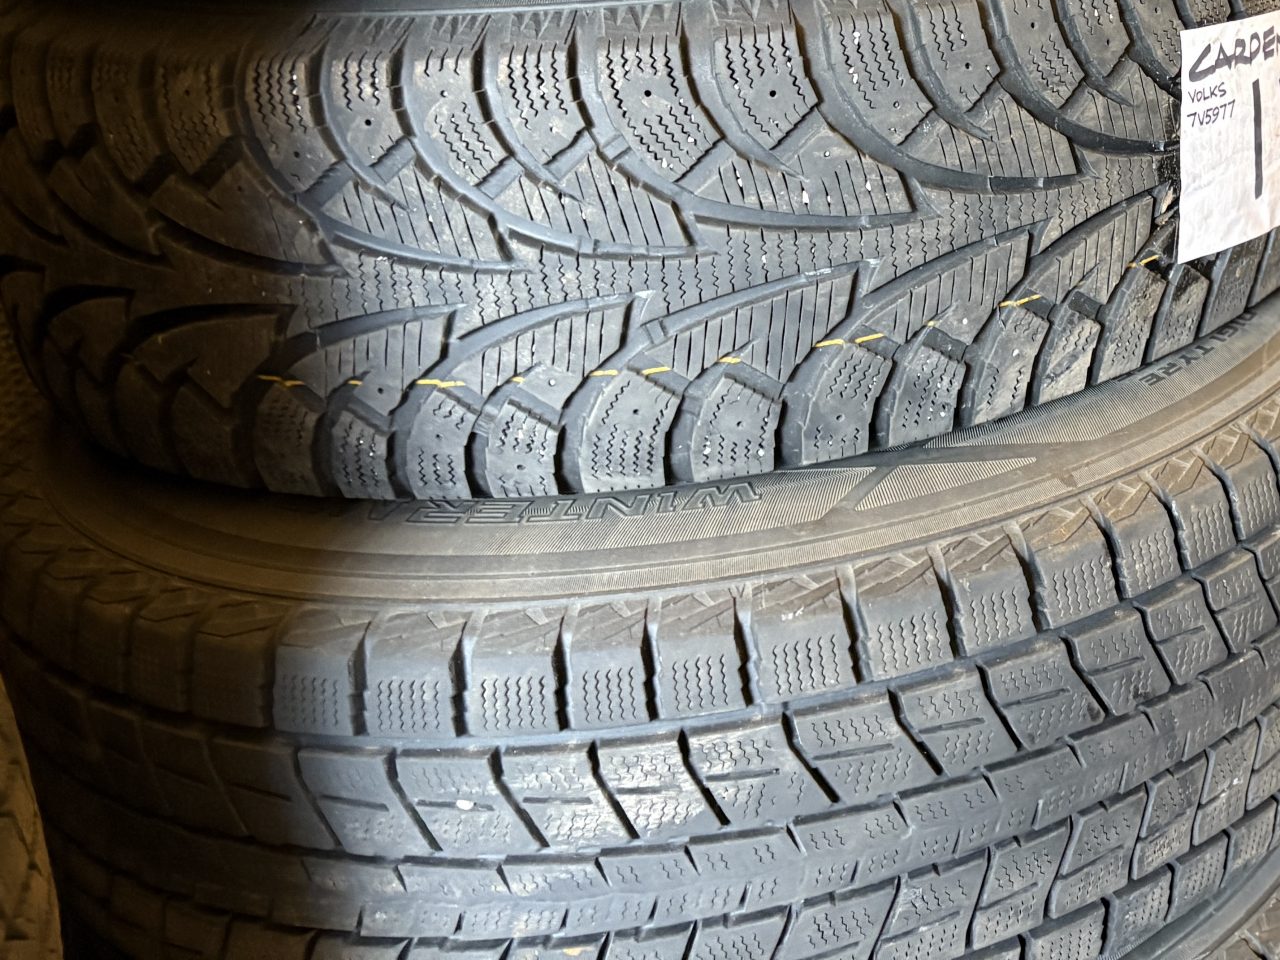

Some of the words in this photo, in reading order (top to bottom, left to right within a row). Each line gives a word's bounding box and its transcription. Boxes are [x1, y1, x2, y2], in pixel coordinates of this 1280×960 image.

[1187, 81, 1227, 104] VOLKS
[1186, 98, 1236, 128] 7V5977
[1138, 344, 1217, 386] TYRE
[405, 480, 763, 526] WINTER
